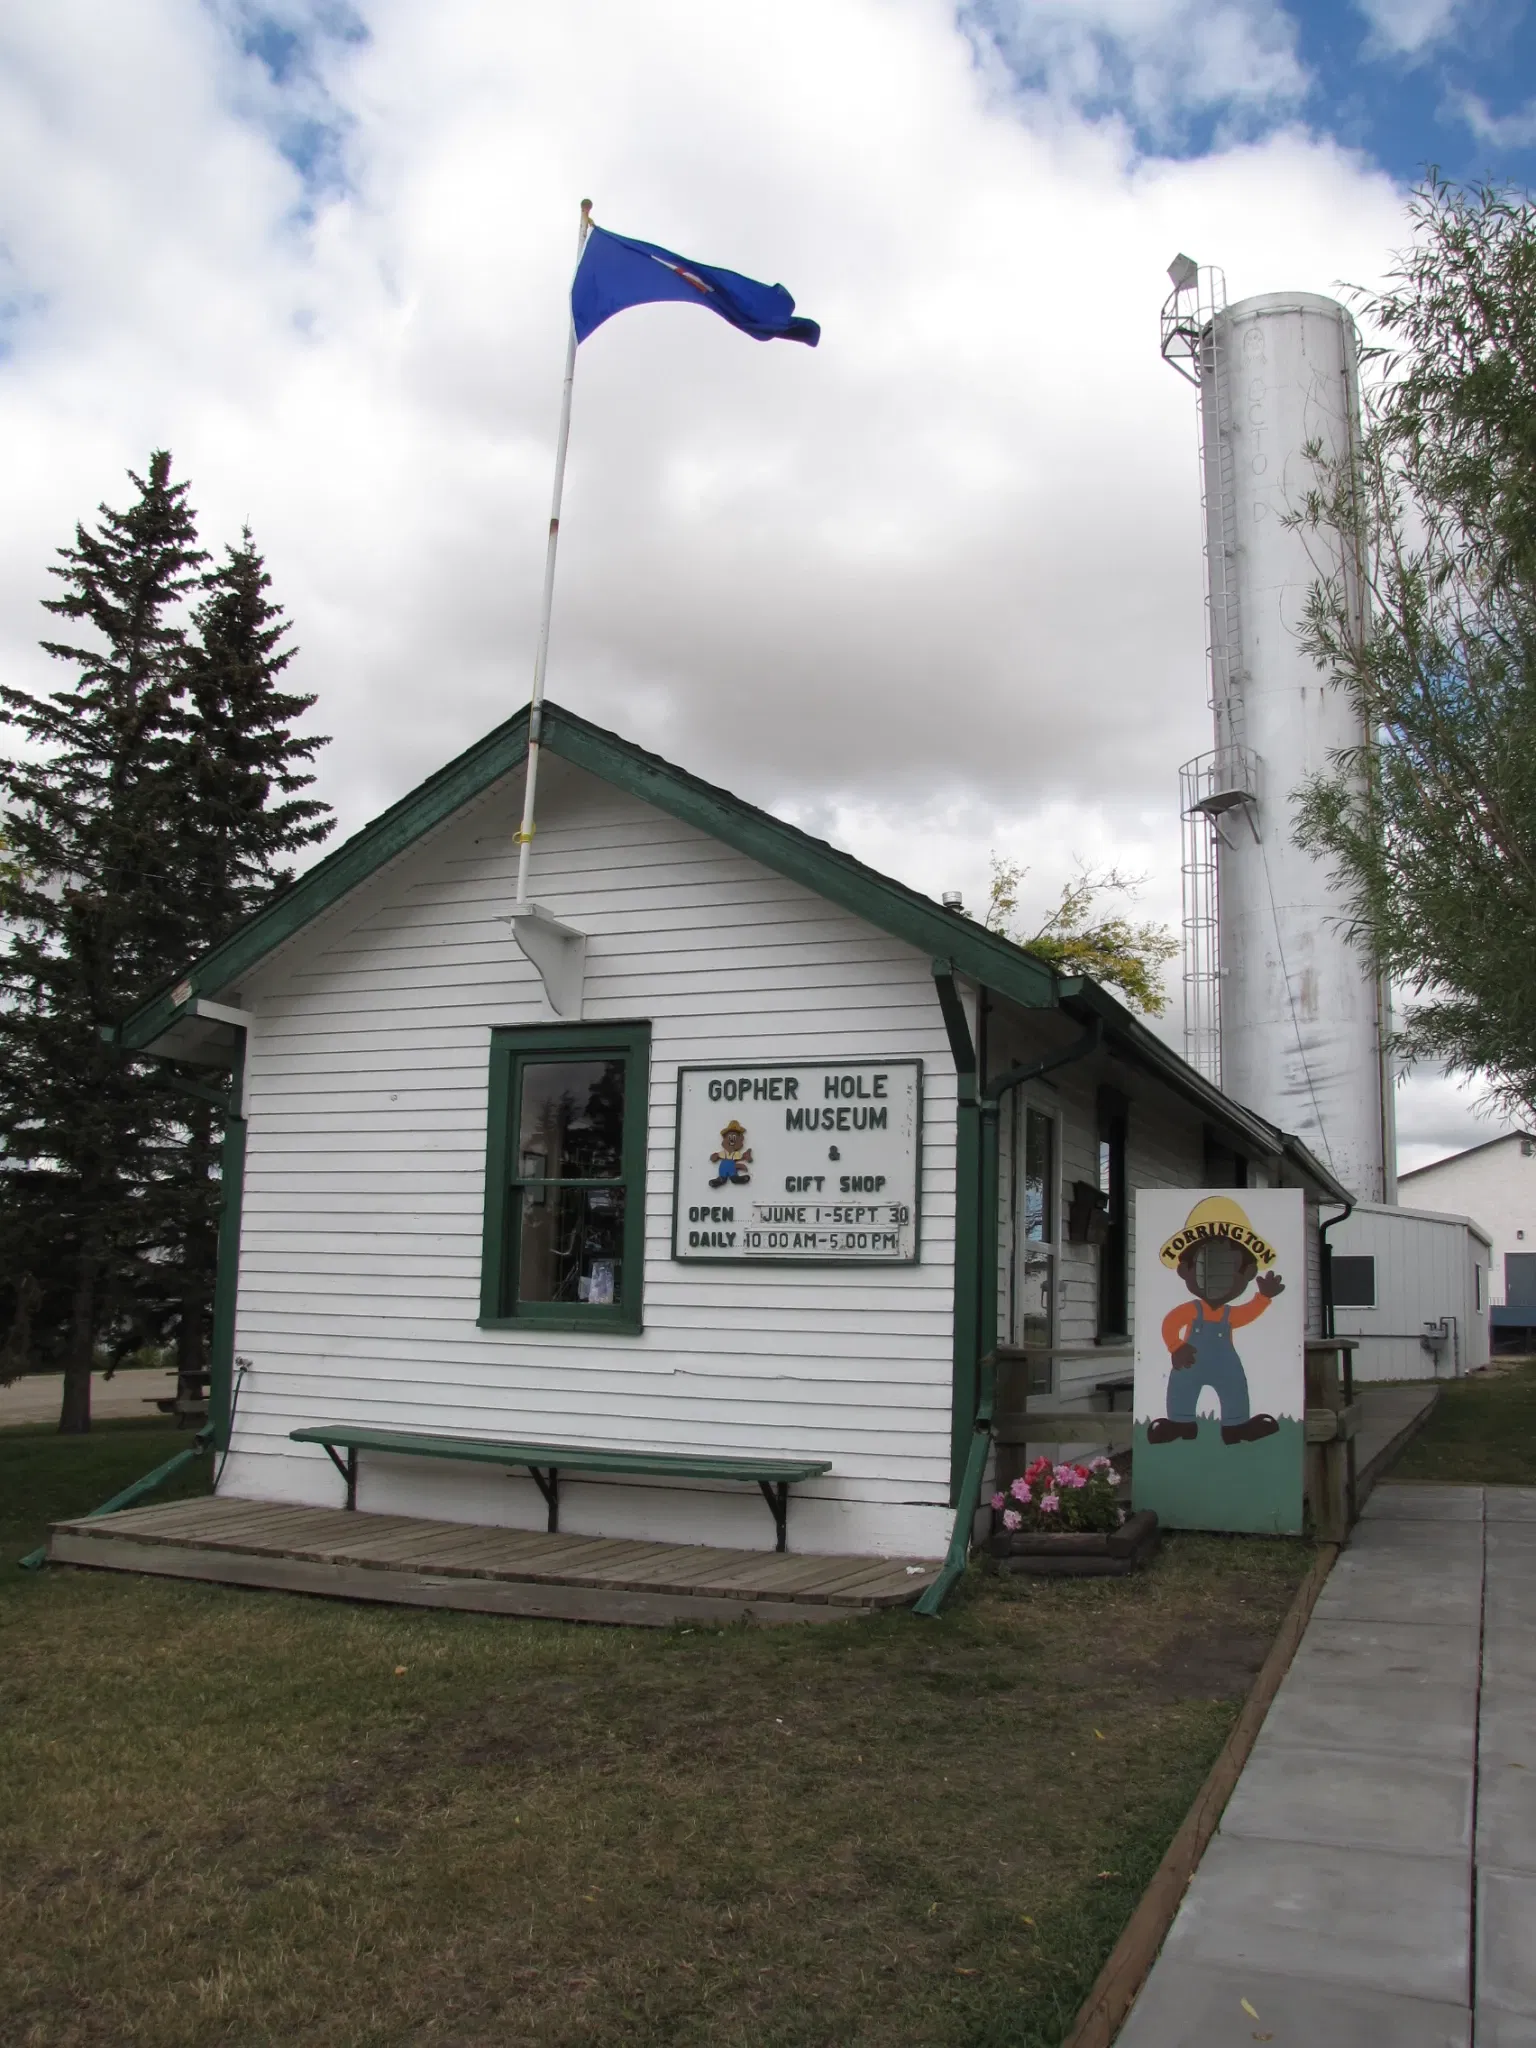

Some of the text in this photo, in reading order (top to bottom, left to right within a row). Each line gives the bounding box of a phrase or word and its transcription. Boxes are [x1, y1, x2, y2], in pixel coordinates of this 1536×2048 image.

[708, 1074, 888, 1101] GOPHER HOLE
[786, 1106, 888, 1131] MUSEUM
[828, 1145, 841, 1161] &
[785, 1175, 886, 1192] GIFT SHOP
[688, 1206, 735, 1222] OPEN
[762, 1207, 806, 1223] JUNE
[888, 1206, 909, 1223] 30
[688, 1231, 737, 1248] DAILY
[1162, 1222, 1277, 1264] TORRINGTON
